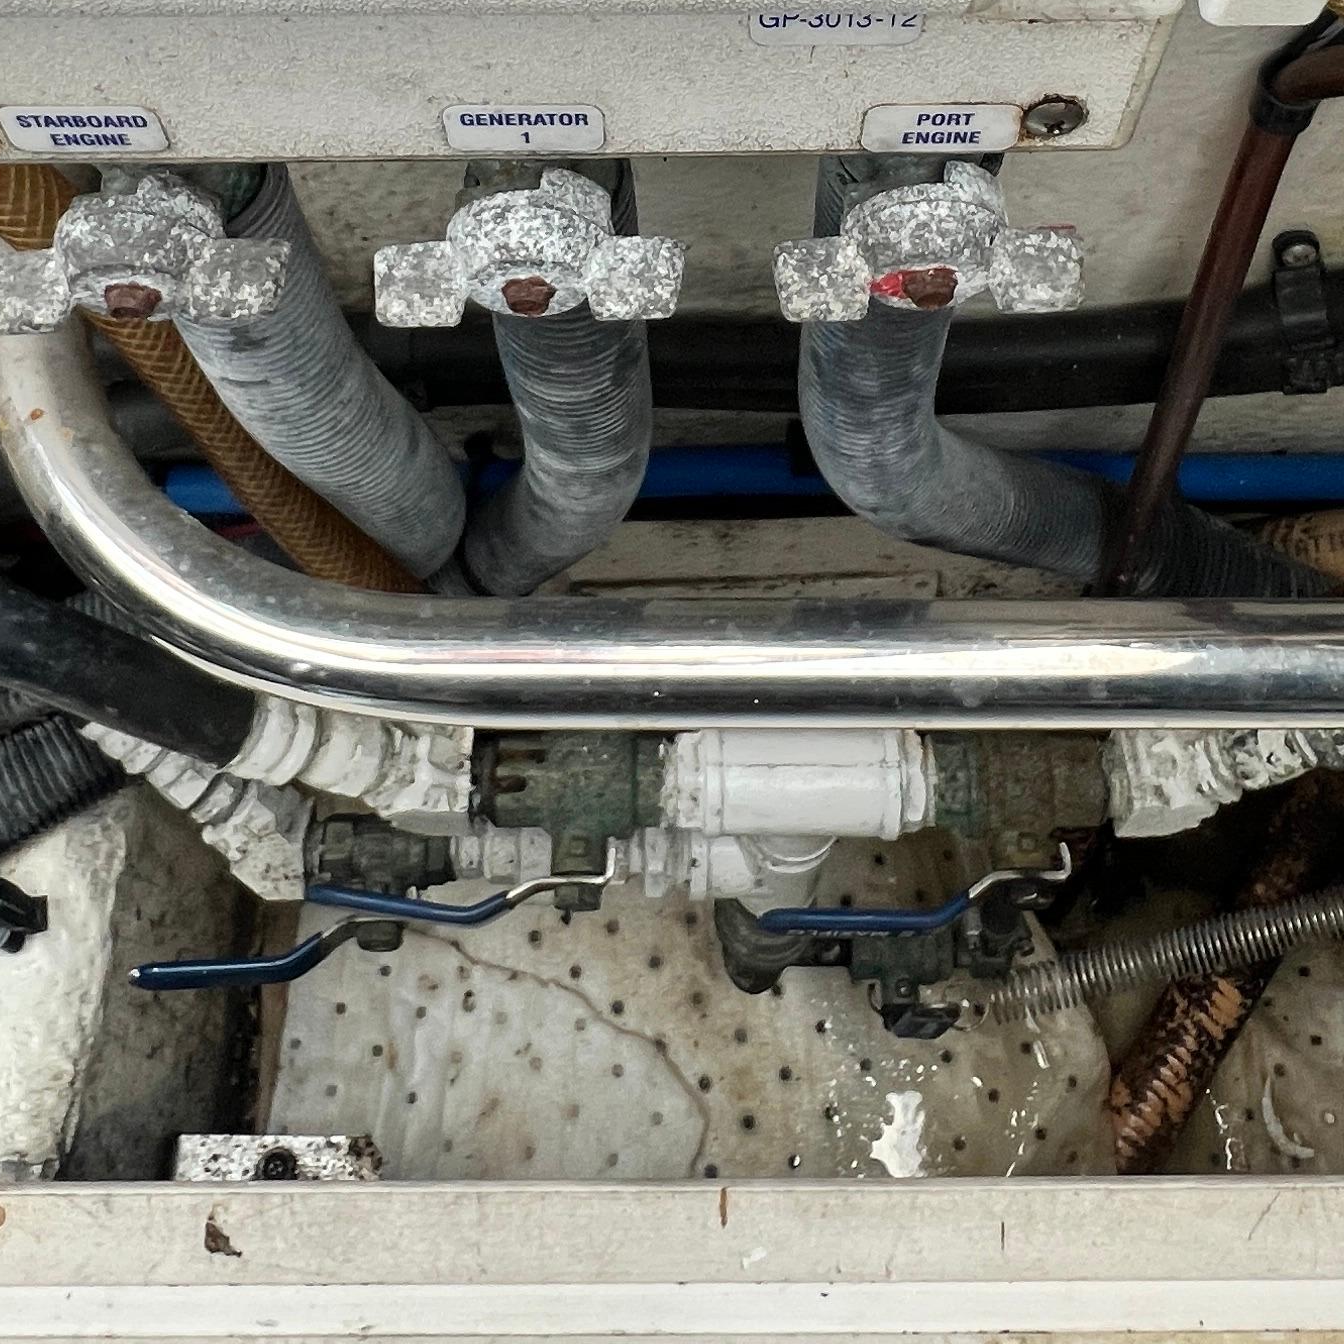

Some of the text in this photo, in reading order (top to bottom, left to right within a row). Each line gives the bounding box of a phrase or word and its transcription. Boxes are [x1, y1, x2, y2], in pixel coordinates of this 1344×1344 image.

[16, 114, 148, 128] STARBOARD
[459, 113, 589, 126] GENERATOR
[916, 112, 976, 126] PORT
[50, 133, 132, 146] ENGINE
[520, 131, 530, 144] 1
[902, 131, 982, 144] ENGINE
